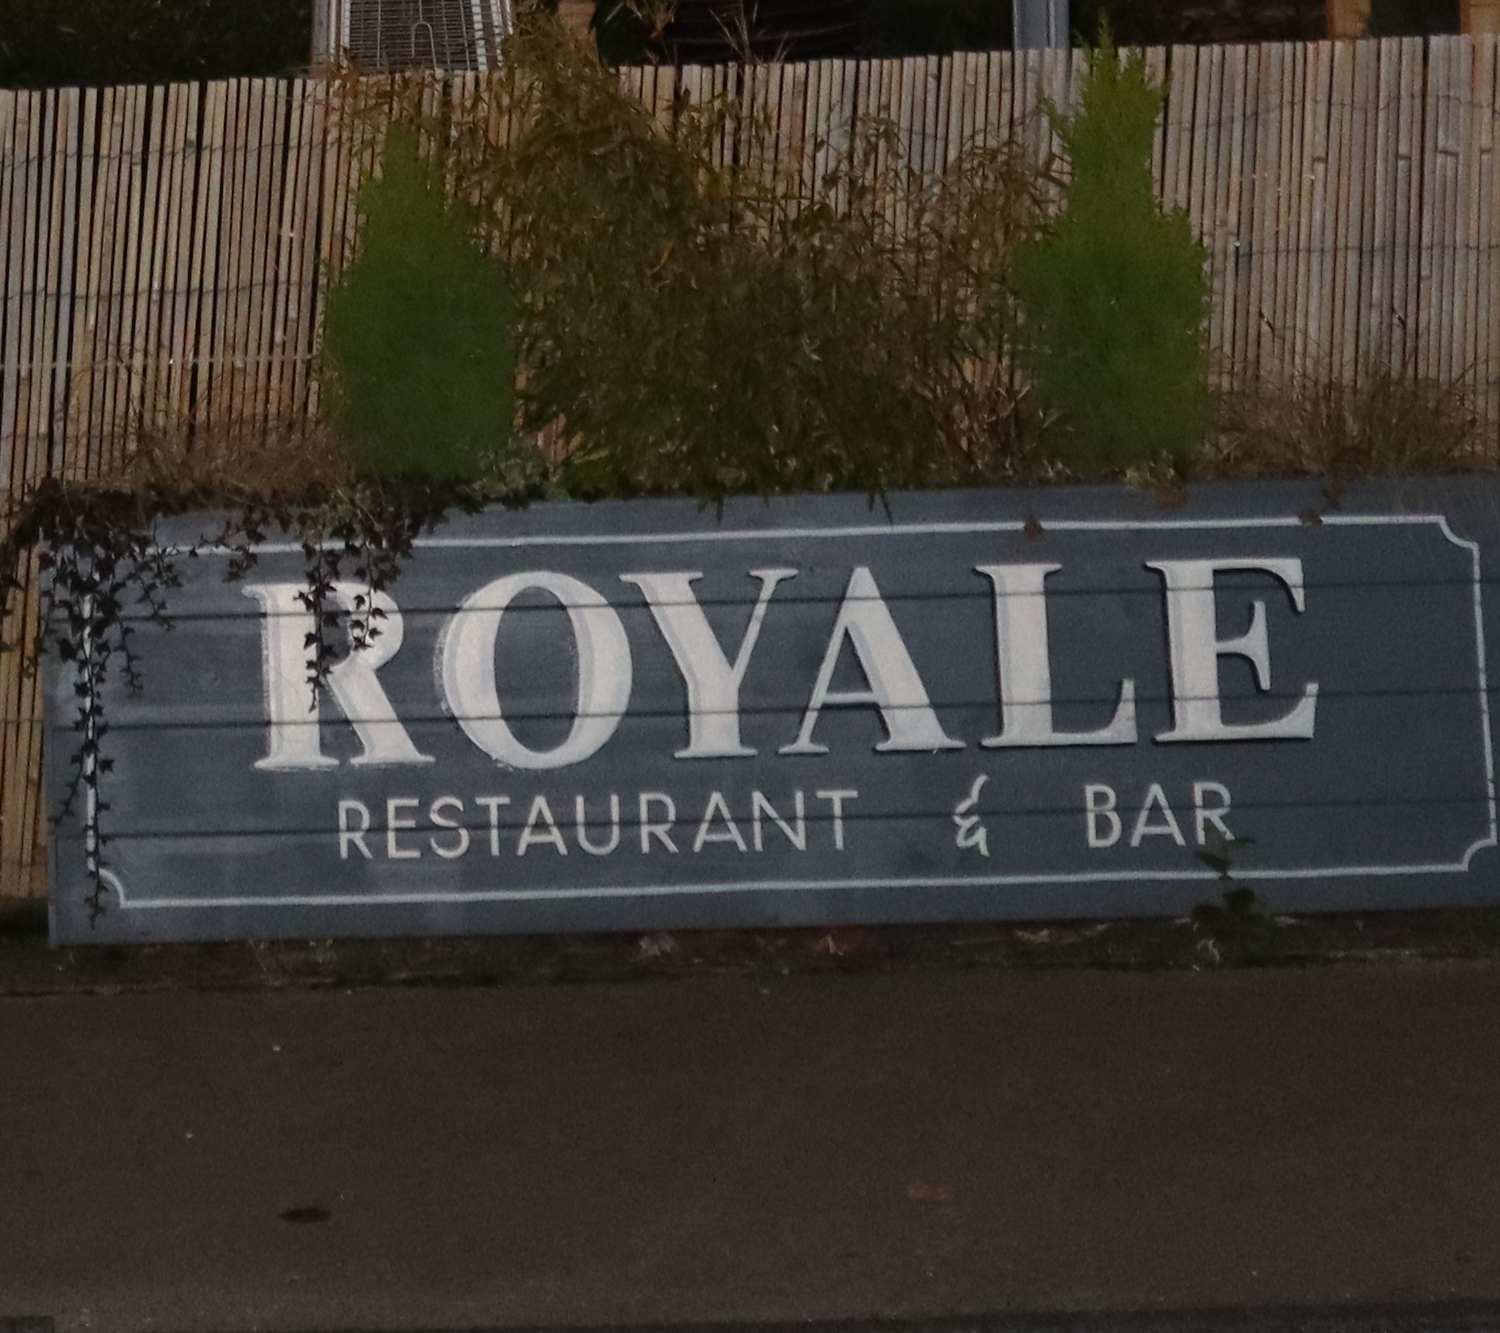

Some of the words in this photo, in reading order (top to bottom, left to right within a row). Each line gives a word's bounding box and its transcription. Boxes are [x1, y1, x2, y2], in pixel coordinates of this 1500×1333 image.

[243, 556, 1320, 773] ROYALE
[339, 788, 860, 862] RESTAURANT
[952, 774, 991, 858] &
[1083, 780, 1236, 851] BAR
